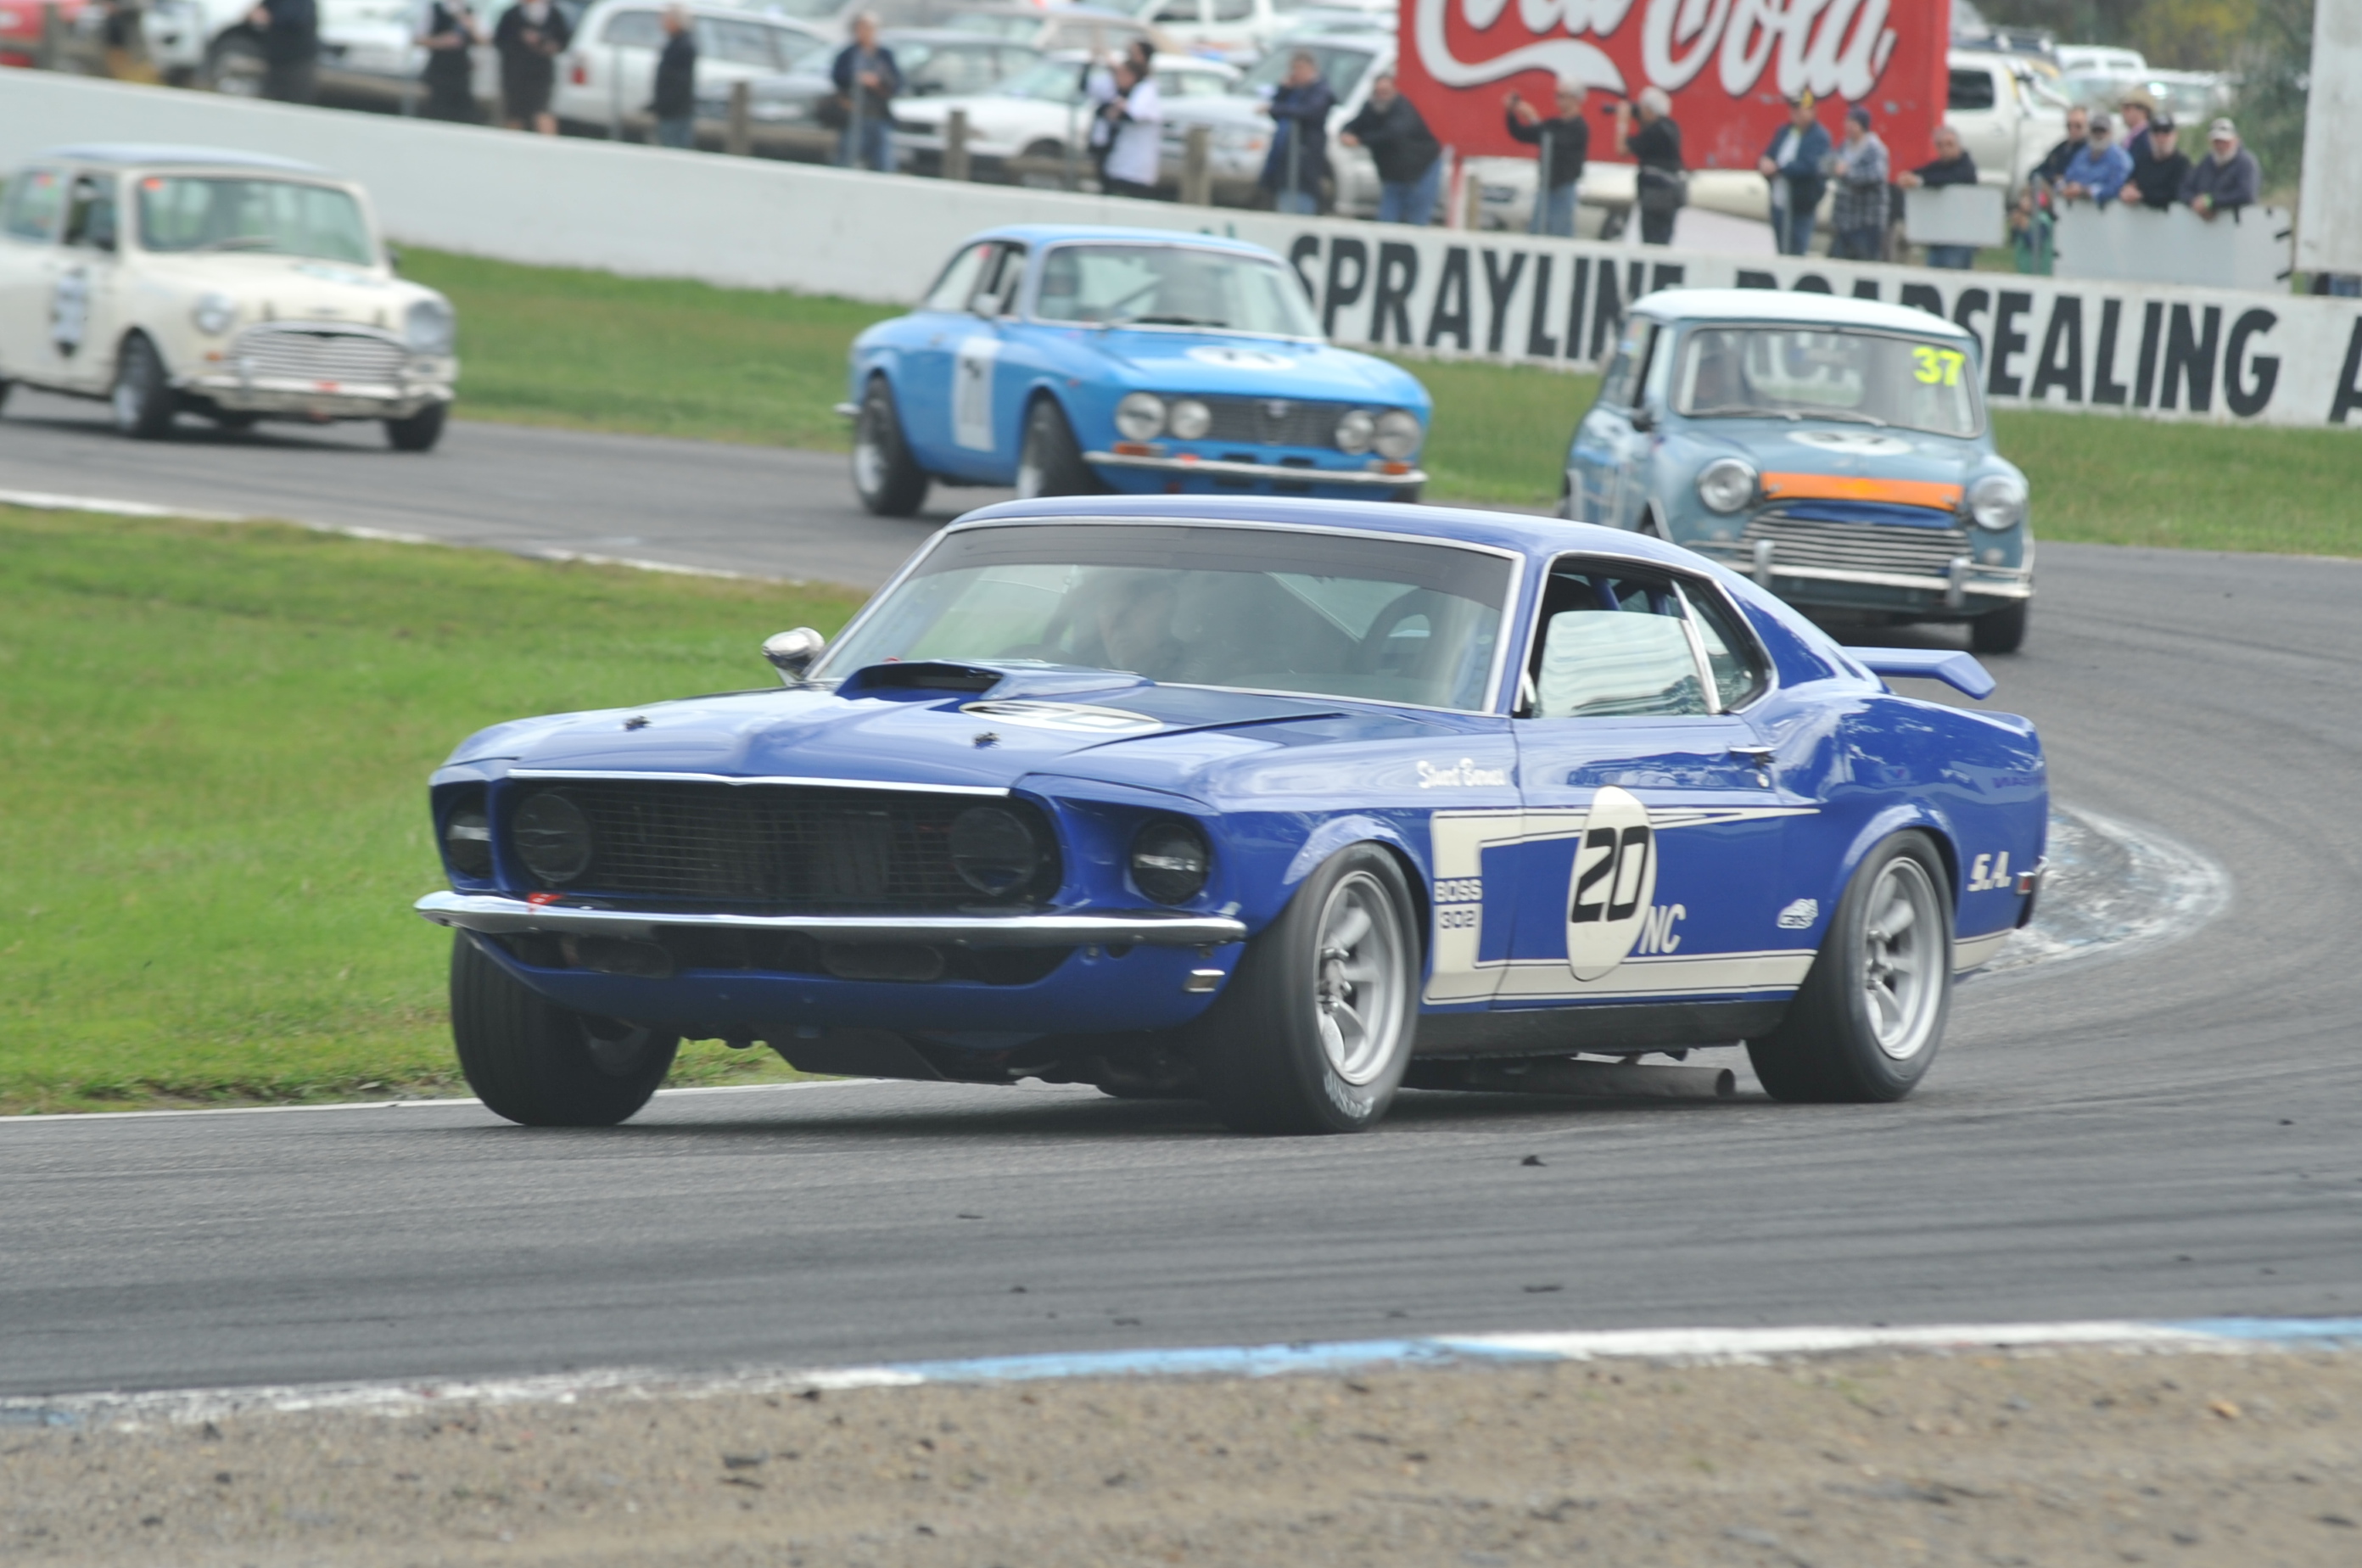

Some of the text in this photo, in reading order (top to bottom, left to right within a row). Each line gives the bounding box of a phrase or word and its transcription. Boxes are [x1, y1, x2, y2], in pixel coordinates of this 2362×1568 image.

[1414, 0, 1899, 101] CCola
[1735, 270, 2281, 417] SEALING
[1912, 345, 1966, 387] 37
[1434, 878, 1483, 903] BOSS
[1570, 825, 1650, 923] 20
[1440, 910, 1476, 930] 302
[1637, 903, 1687, 955] NC
